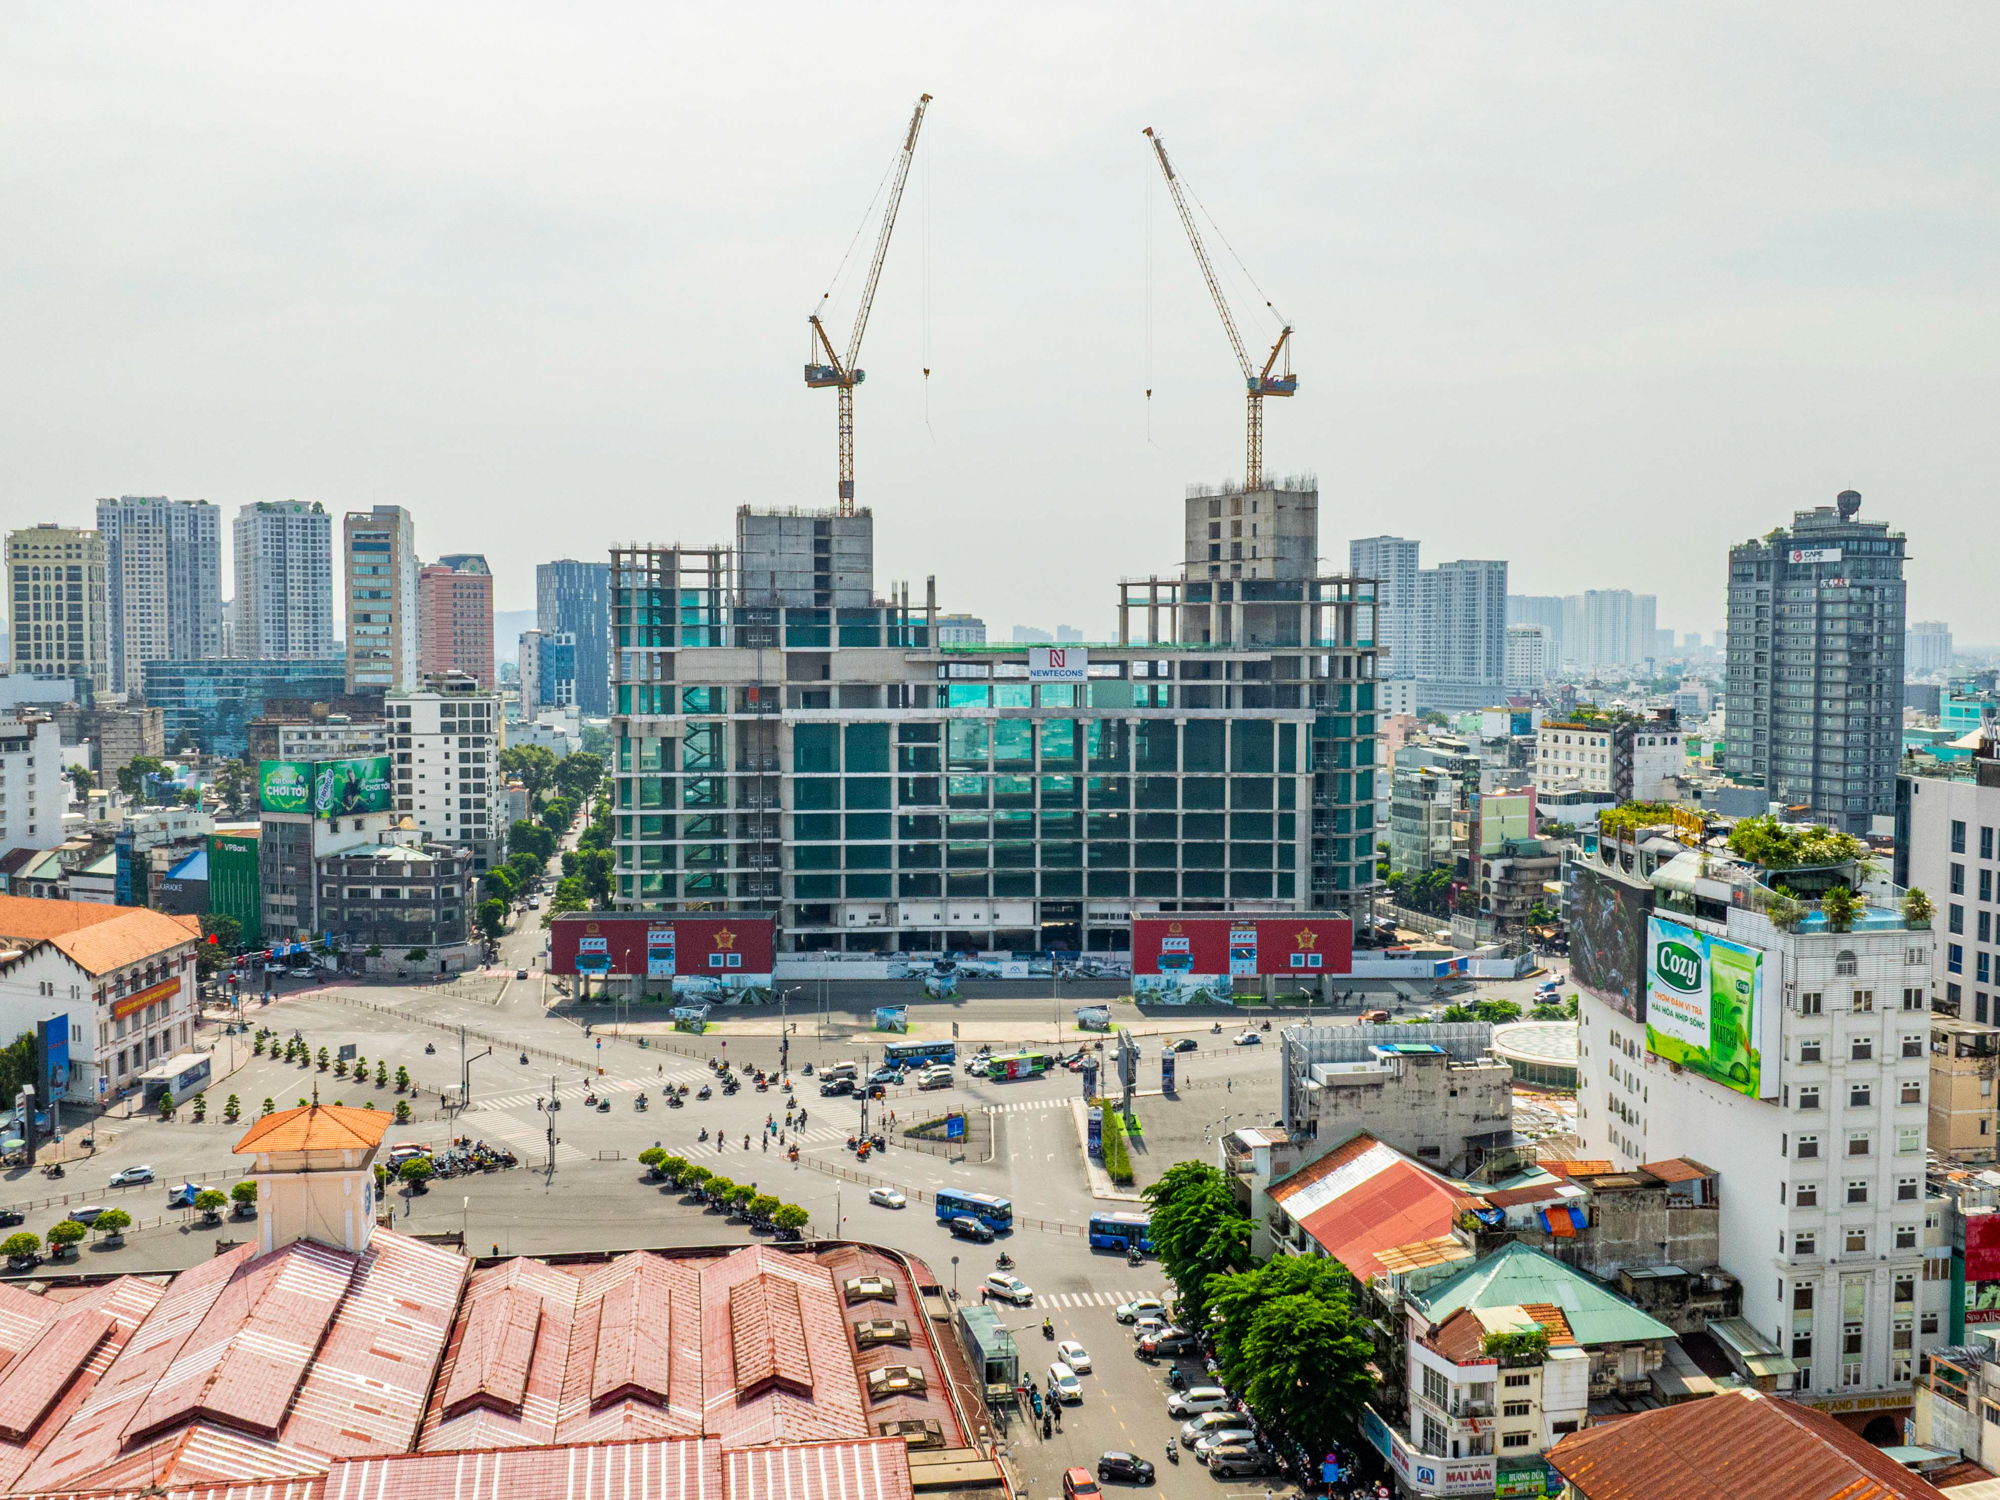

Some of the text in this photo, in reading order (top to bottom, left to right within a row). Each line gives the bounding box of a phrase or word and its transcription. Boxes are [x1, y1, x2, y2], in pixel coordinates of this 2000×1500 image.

[486, 750, 492, 763] EL
[266, 784, 305, 797] CHƠI TỚI
[317, 778, 332, 806] TUBORG
[1660, 946, 1697, 987] Cozy
[1714, 1022, 1738, 1051] MATCHA
[1966, 1313, 1980, 1323] Spa
[1446, 1467, 1492, 1482] MAI VÂN
